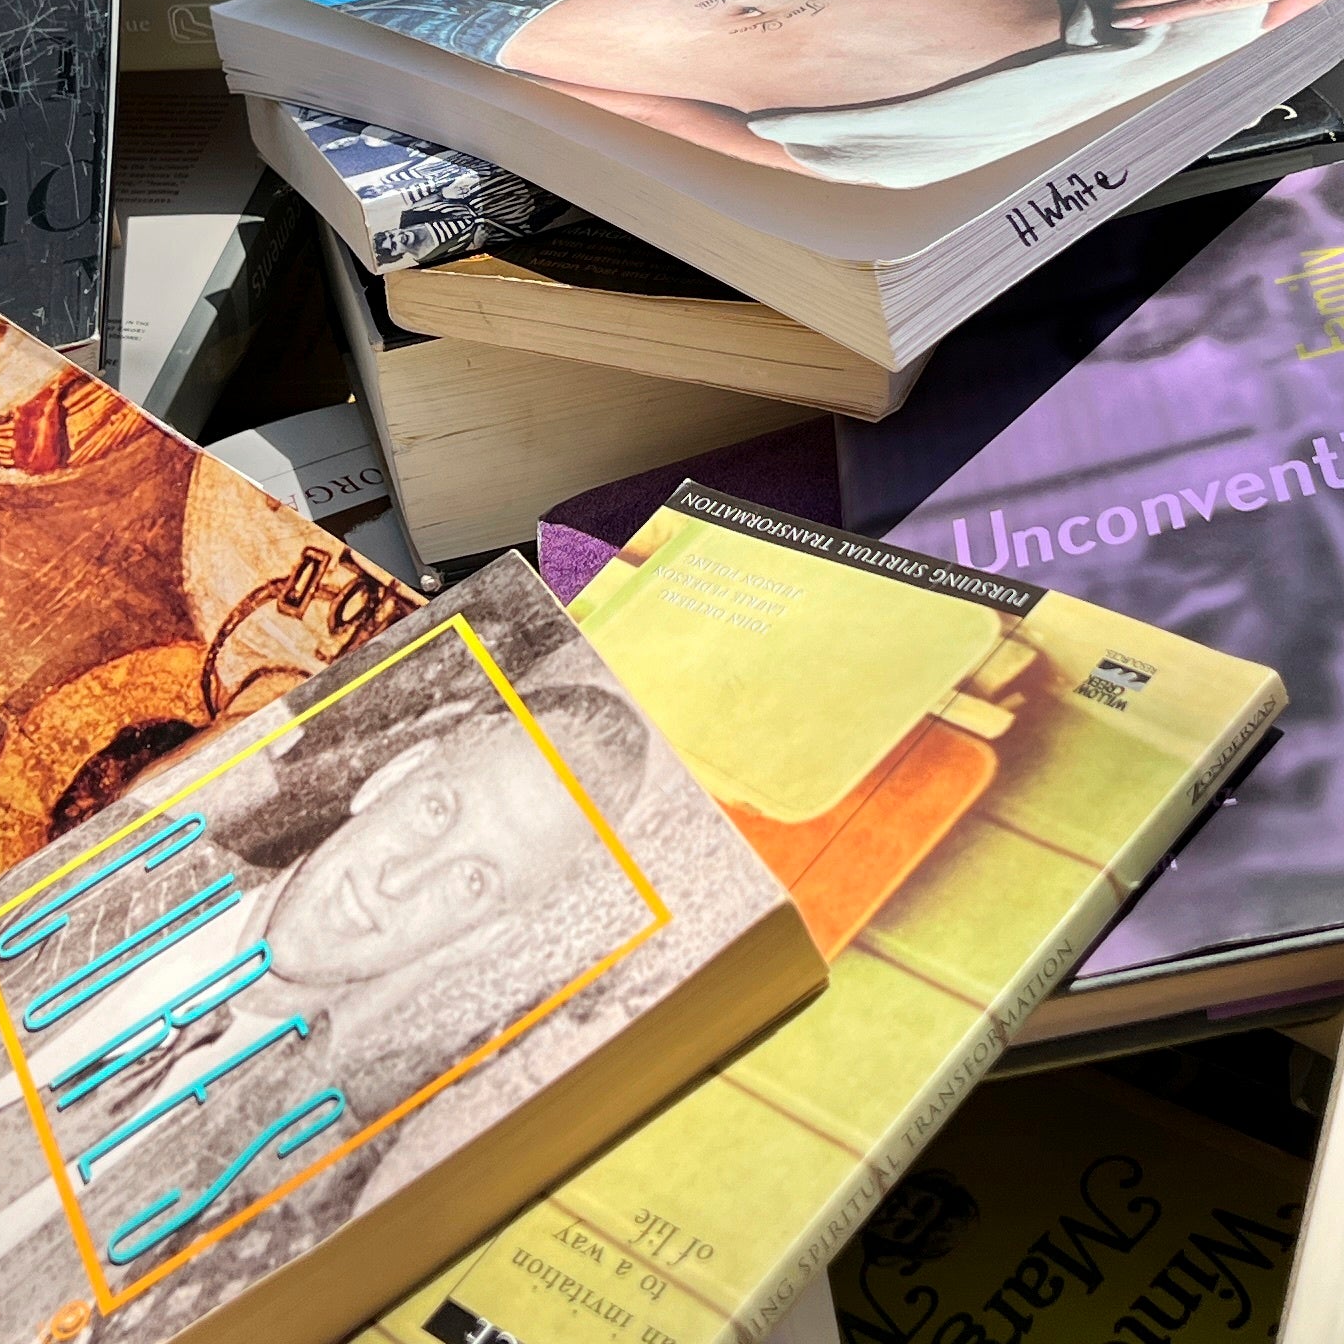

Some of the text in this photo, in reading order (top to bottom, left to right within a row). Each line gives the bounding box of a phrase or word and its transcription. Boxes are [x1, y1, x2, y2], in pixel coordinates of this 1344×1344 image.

[1003, 150, 1136, 249] H White
[678, 489, 1033, 606] PURSUING SPIRITUAL TRANSFORMATION
[1071, 682, 1129, 712] WILLOW
[1085, 673, 1126, 697] CREEK
[1184, 693, 1279, 806] ZONDERVAN
[792, 933, 1077, 1279] SPIRITUAL TRANSFORMATION
[552, 1217, 668, 1301] to a way
[626, 1207, 714, 1266] of life
[511, 1245, 636, 1341] invitation
